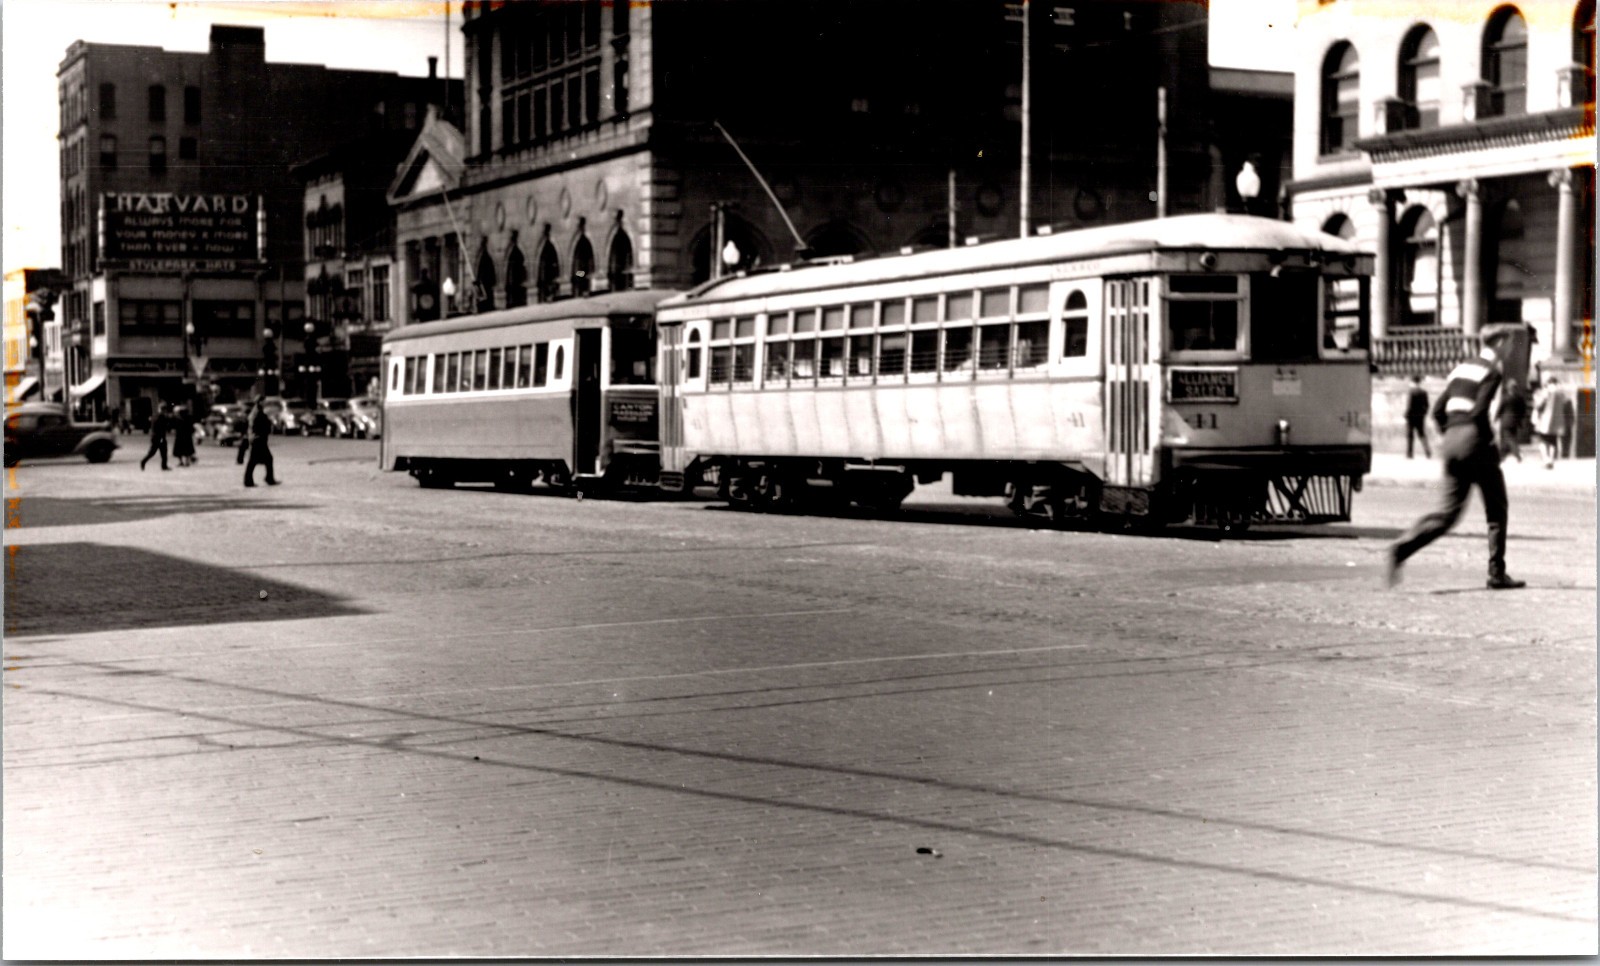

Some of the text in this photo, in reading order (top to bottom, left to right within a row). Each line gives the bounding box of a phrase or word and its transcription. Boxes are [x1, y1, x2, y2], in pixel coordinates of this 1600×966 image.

[117, 194, 249, 213] HARVARD
[1178, 373, 1234, 386] ALLIANCE
[1185, 385, 1227, 397] SALEM
[1066, 411, 1086, 428] 41
[1183, 412, 1219, 430] 41
